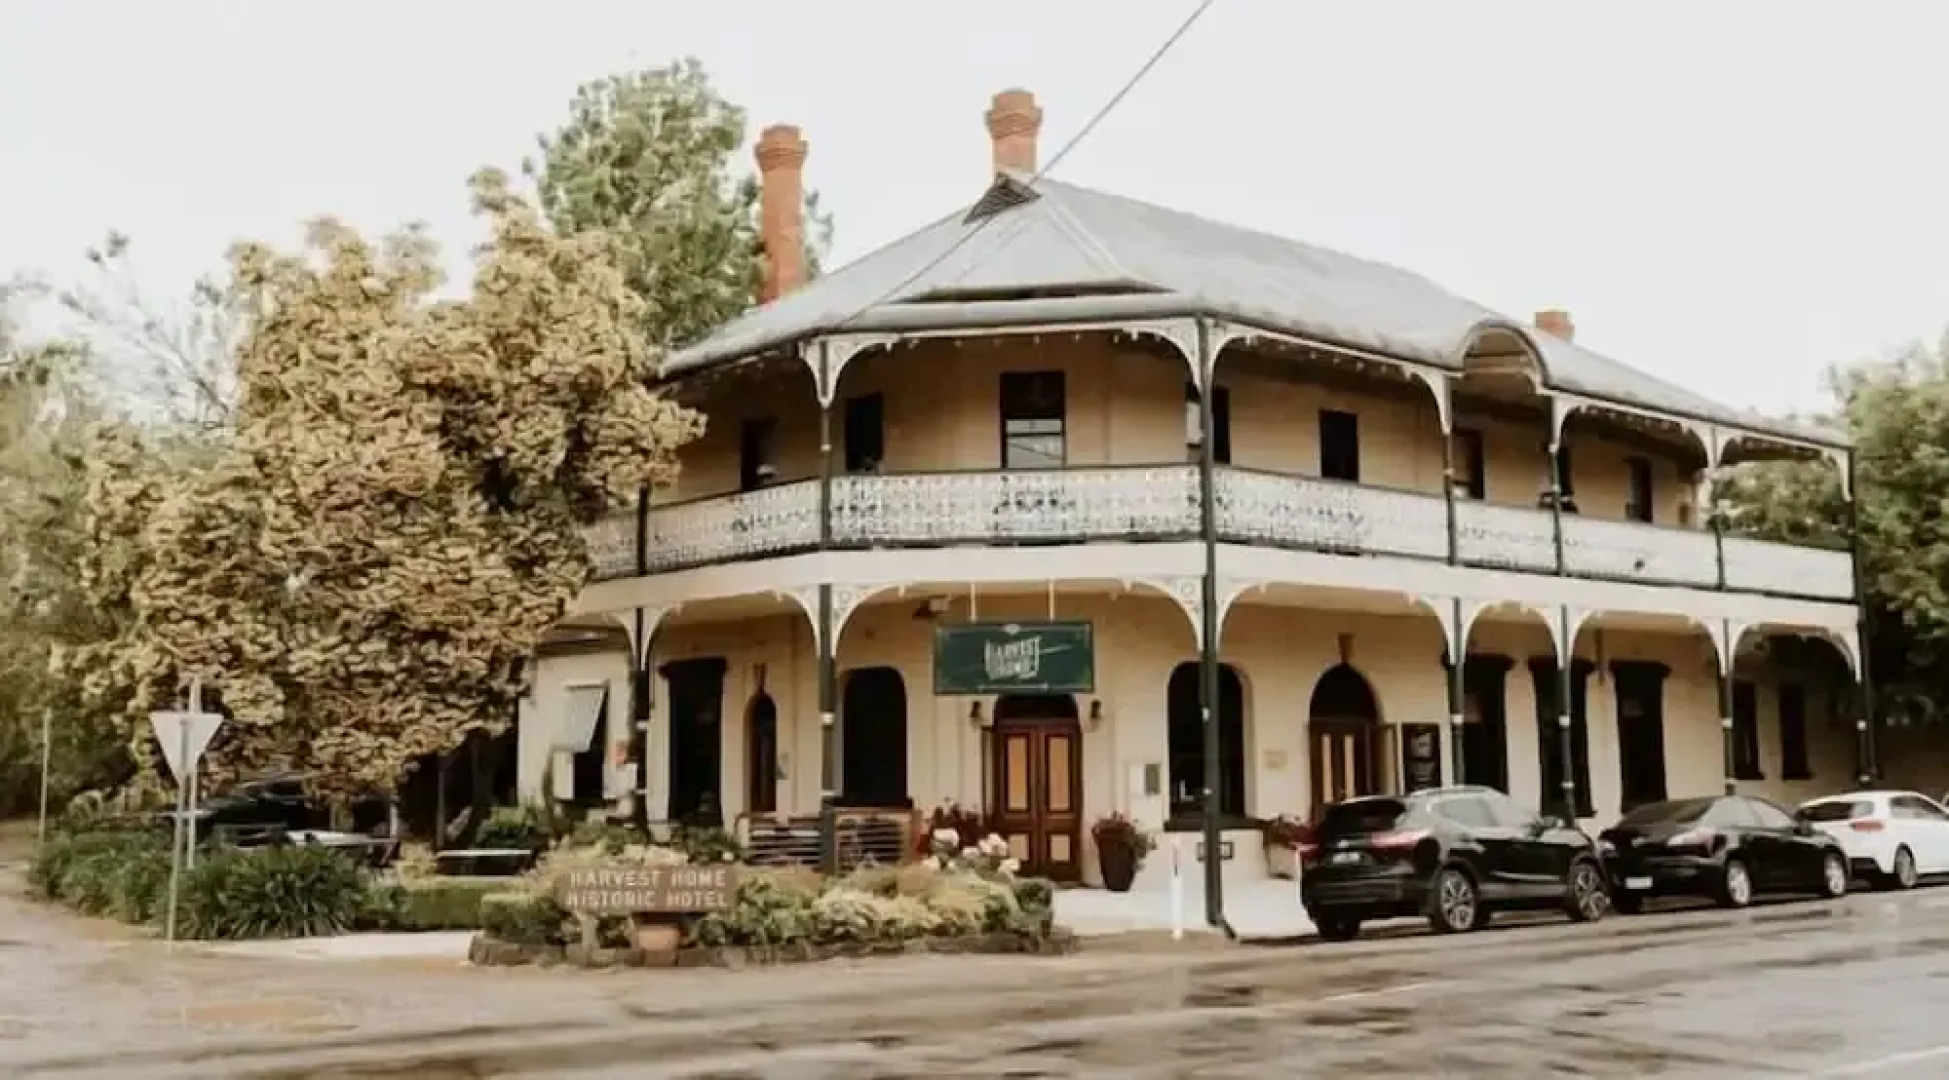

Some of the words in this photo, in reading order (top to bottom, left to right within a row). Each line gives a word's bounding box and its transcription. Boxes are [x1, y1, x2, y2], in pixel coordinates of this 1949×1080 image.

[570, 870, 663, 887] HARVEST
[671, 869, 726, 887] HOME
[567, 889, 656, 907] HISTORIC
[665, 889, 728, 907] HOTEL
